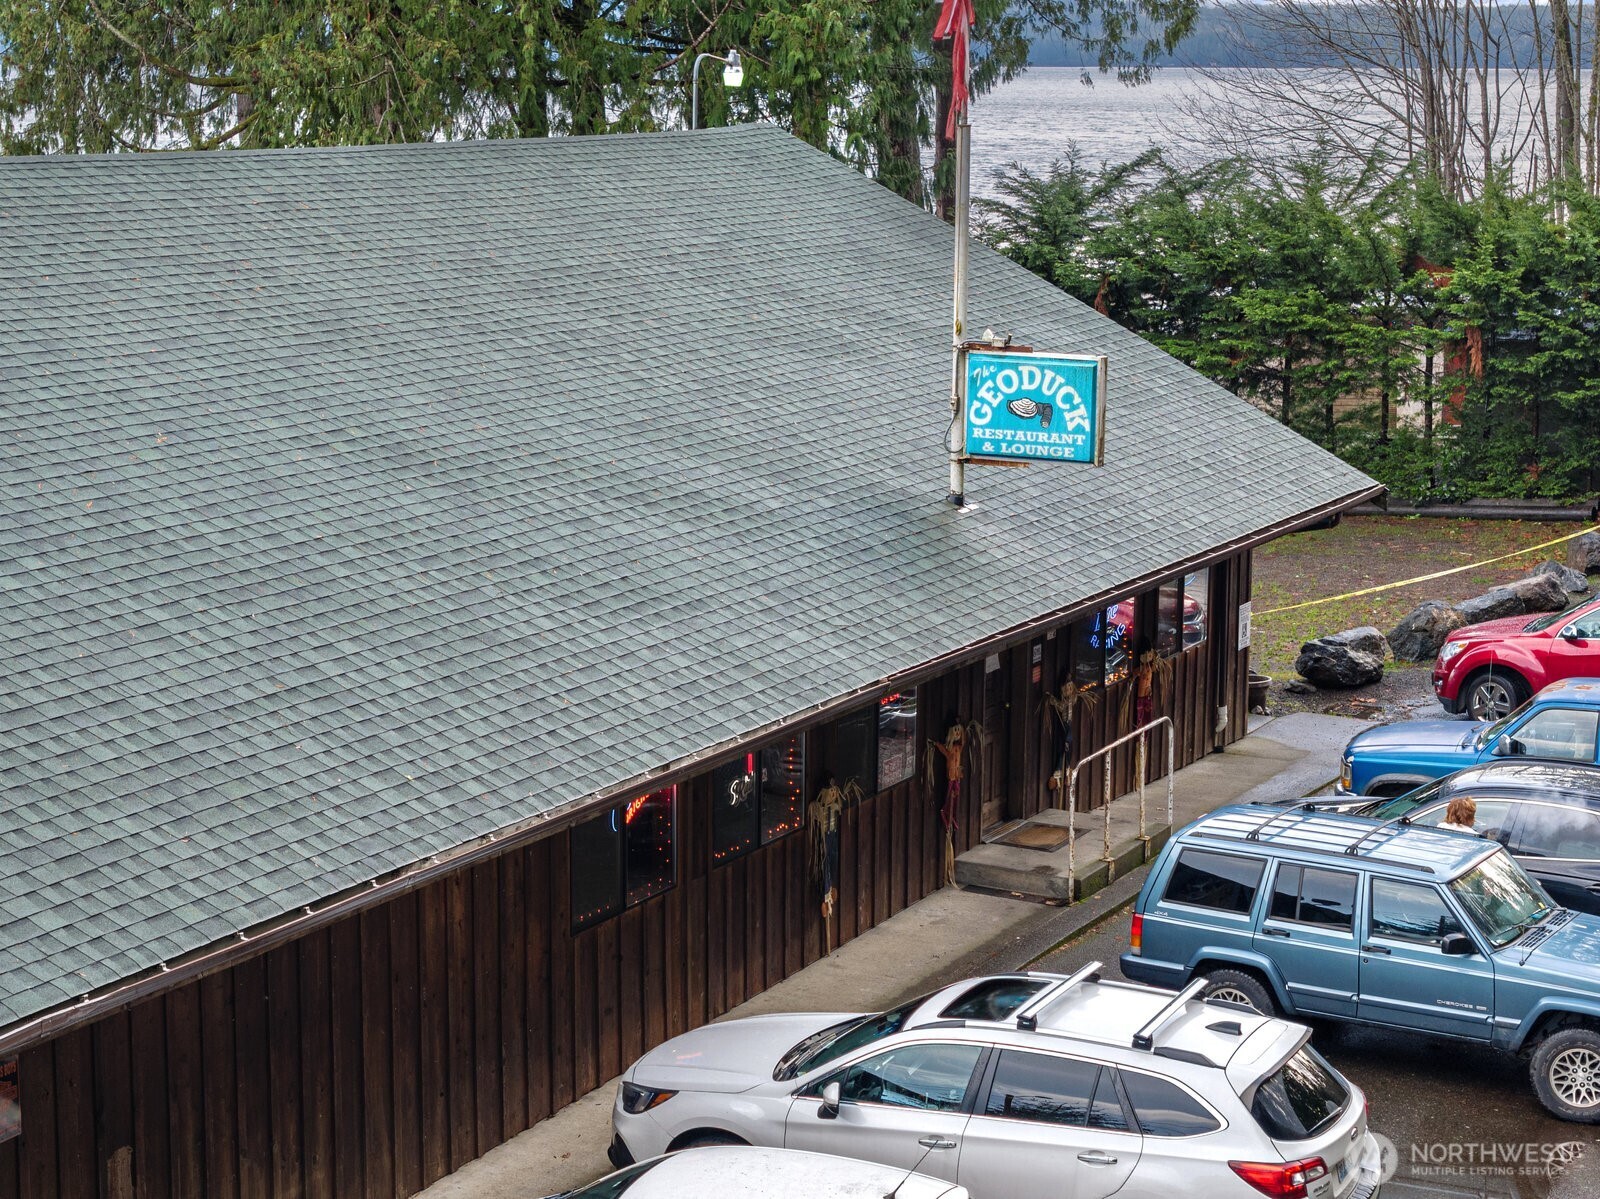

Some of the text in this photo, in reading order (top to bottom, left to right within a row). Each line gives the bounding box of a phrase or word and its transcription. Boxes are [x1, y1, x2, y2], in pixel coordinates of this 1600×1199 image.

[970, 365, 997, 386] The
[969, 365, 1091, 432] GEODUCK
[972, 427, 1086, 446] RESTAURANT
[981, 441, 1075, 458] & LOUNGE
